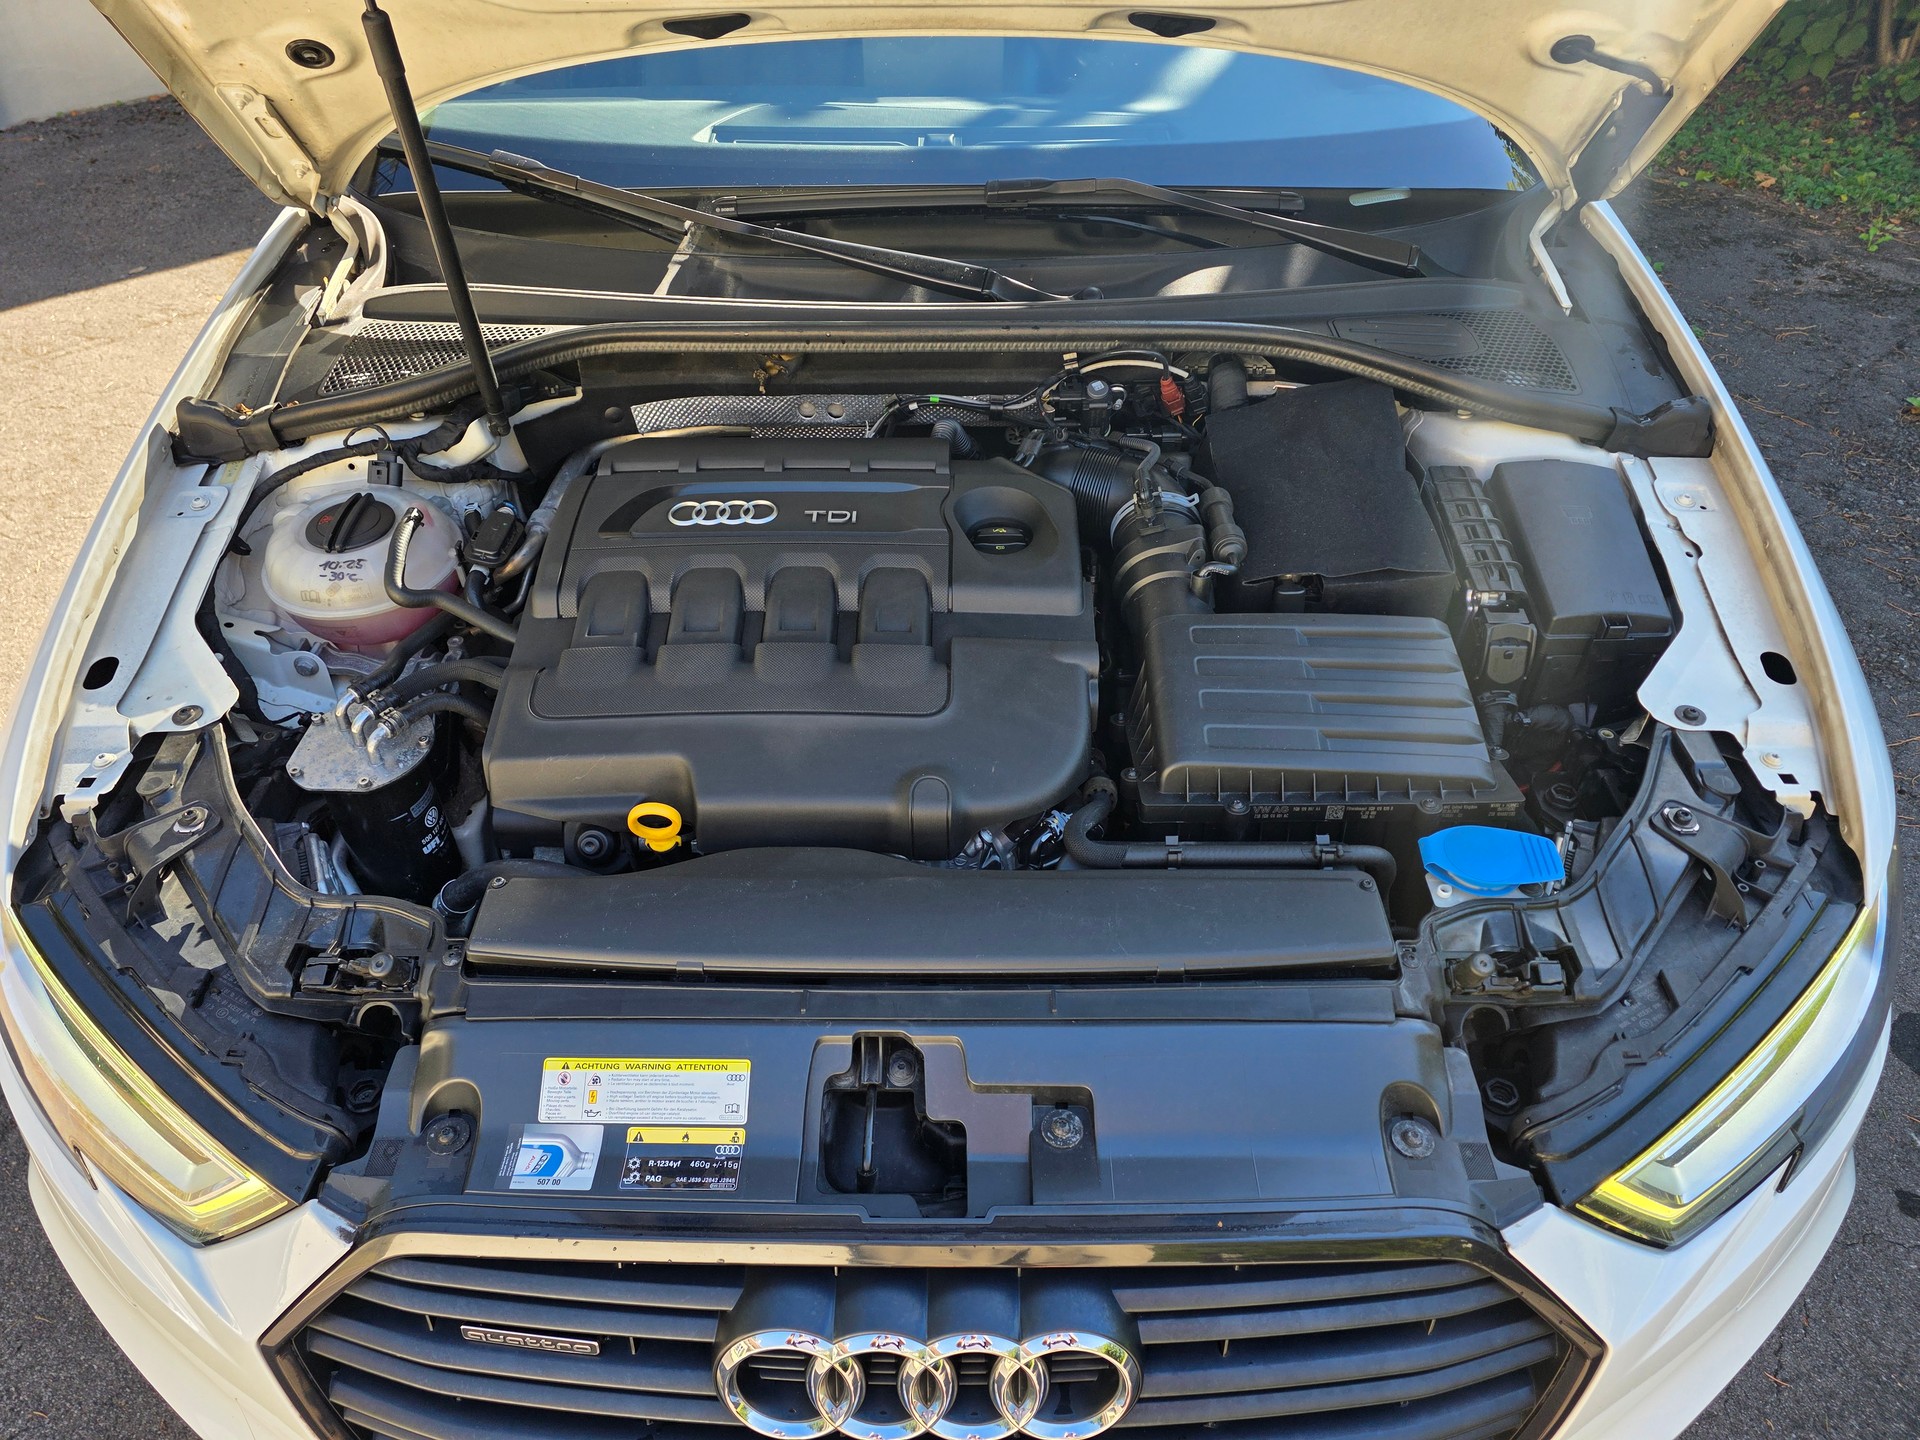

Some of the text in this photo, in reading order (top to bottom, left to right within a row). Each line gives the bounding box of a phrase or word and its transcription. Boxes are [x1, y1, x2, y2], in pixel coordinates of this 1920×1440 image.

[804, 509, 857, 524] TDI
[422, 836, 440, 855] UFI
[648, 1160, 682, 1169] R-1234yf
[690, 1160, 710, 1169] 460g
[467, 1330, 592, 1353] quattro
